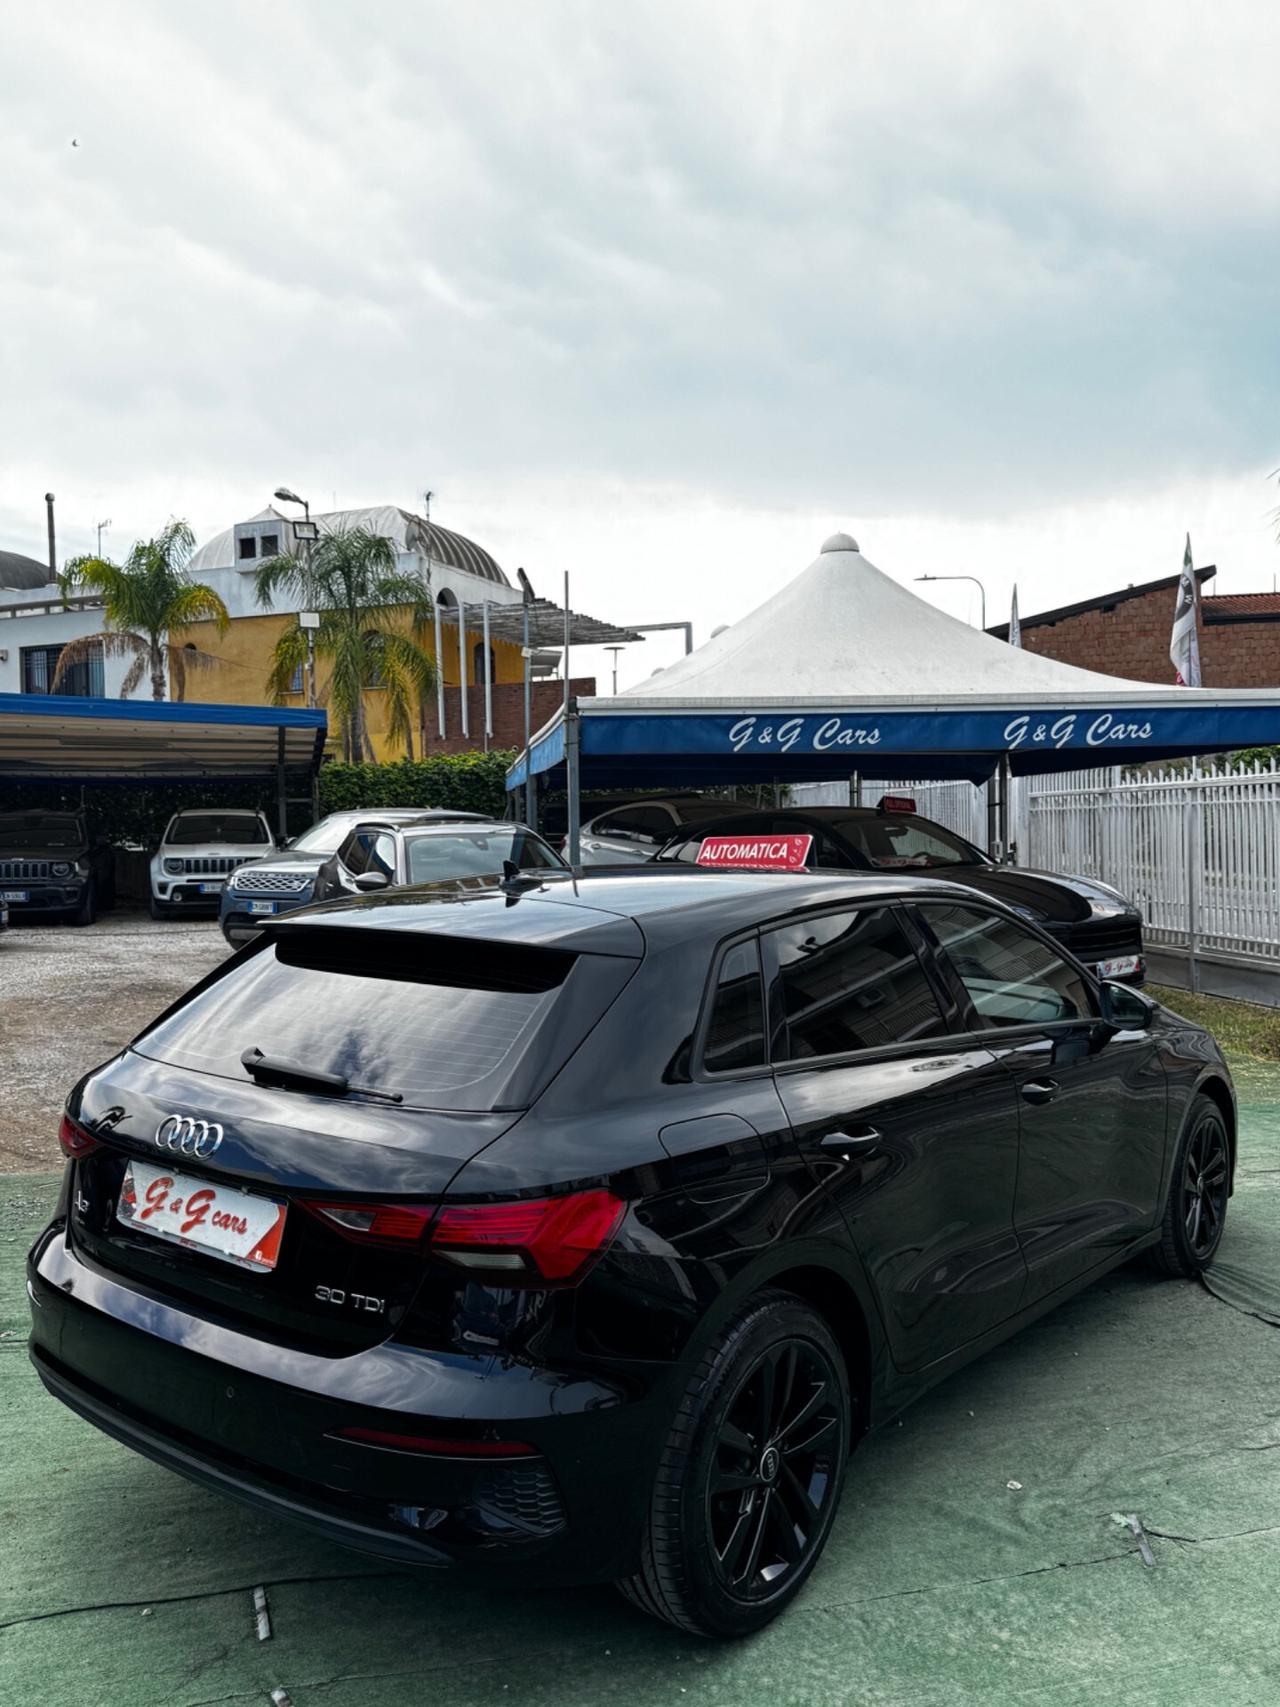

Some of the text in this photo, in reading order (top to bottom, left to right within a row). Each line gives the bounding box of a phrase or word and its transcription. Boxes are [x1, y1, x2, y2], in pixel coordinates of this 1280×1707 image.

[813, 718, 881, 750] Cars
[1086, 713, 1152, 746] Cars
[701, 843, 788, 860] AUTOMATICA
[211, 1210, 247, 1235] cars
[315, 1285, 385, 1313] 30 TDI
